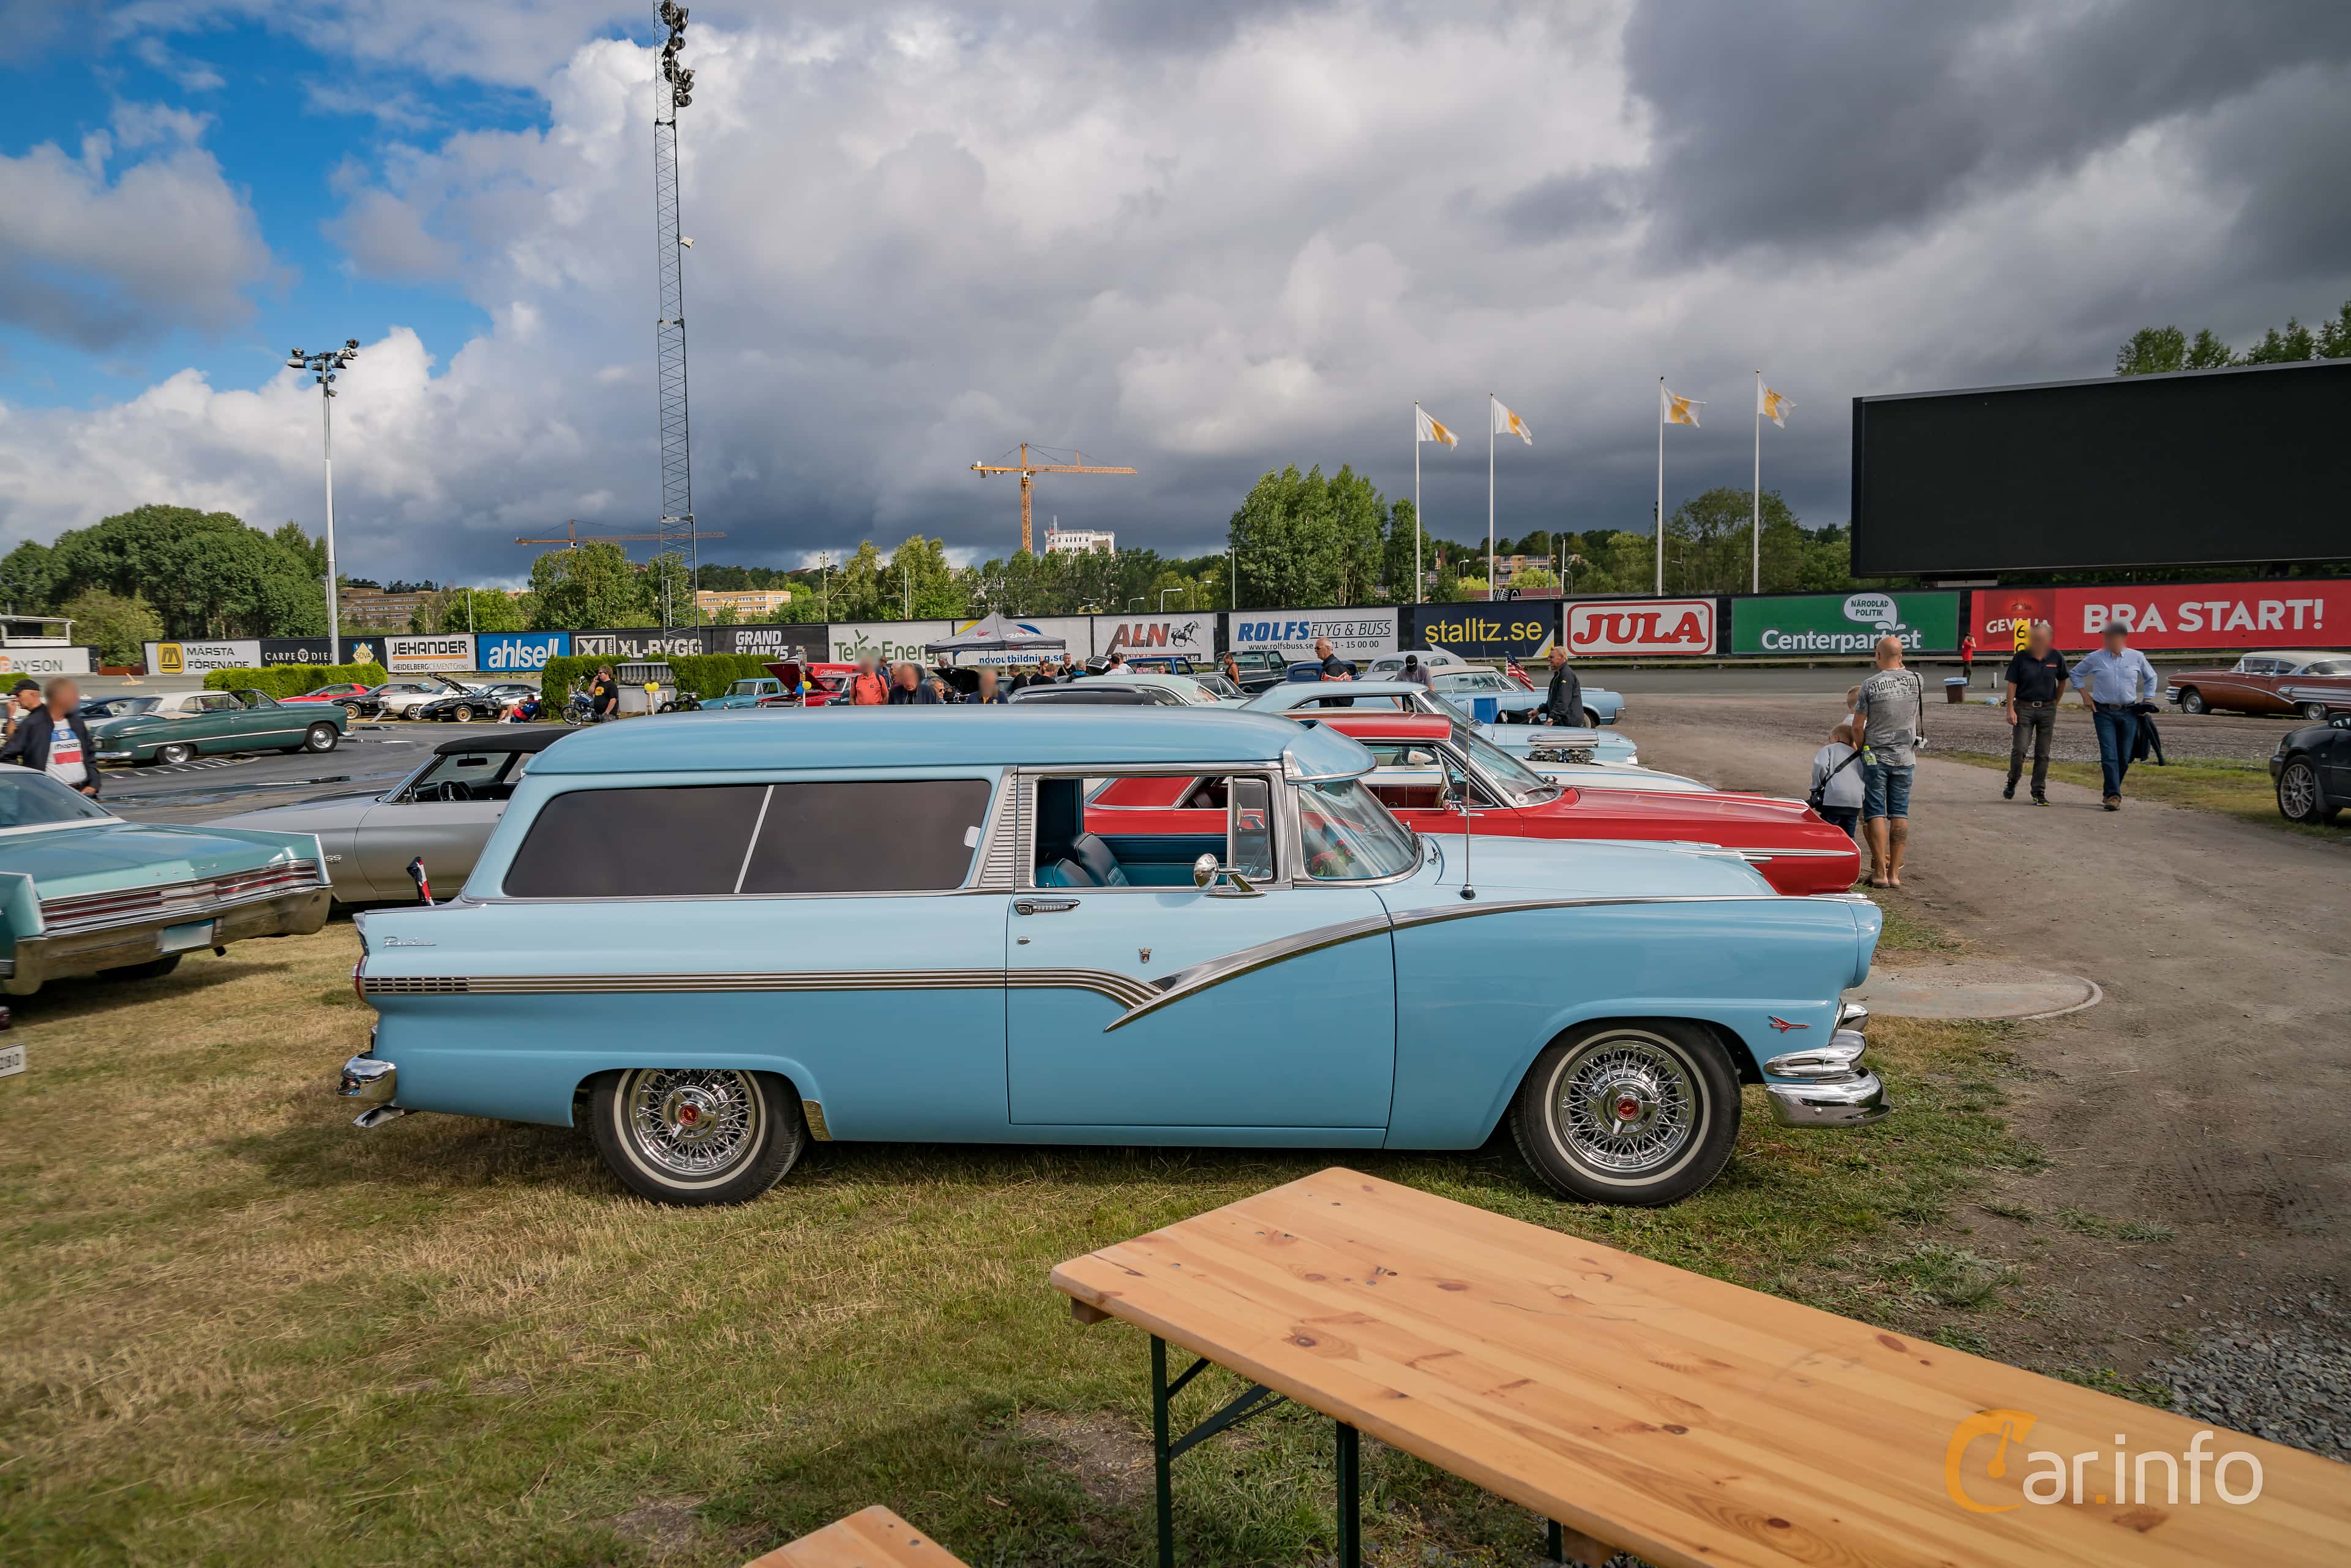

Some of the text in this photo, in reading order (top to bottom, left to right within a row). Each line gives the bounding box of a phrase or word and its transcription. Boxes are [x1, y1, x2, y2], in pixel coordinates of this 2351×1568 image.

[1851, 599, 1889, 608] NÄRODLAD
[2083, 599, 2323, 633] BRA START!
[1237, 621, 1391, 642] ROLFS FLYG & BUSS
[1425, 618, 1542, 643] stalltz.se
[1573, 612, 1706, 644] JULA
[735, 631, 782, 645] GRAND
[1104, 623, 1171, 656] ALN
[1762, 629, 1921, 653] Centerparet
[187, 645, 235, 656] MÄRSTA
[392, 640, 467, 655] JEHANDER
[489, 639, 558, 668] ahlsell
[1248, 642, 1313, 650] www.rolfsbuss.se
[188, 659, 250, 669] FÖRENADE
[265, 652, 295, 661] CARPE
[312, 652, 332, 661] DIE
[980, 654, 1063, 664] novoutbildnig.se
